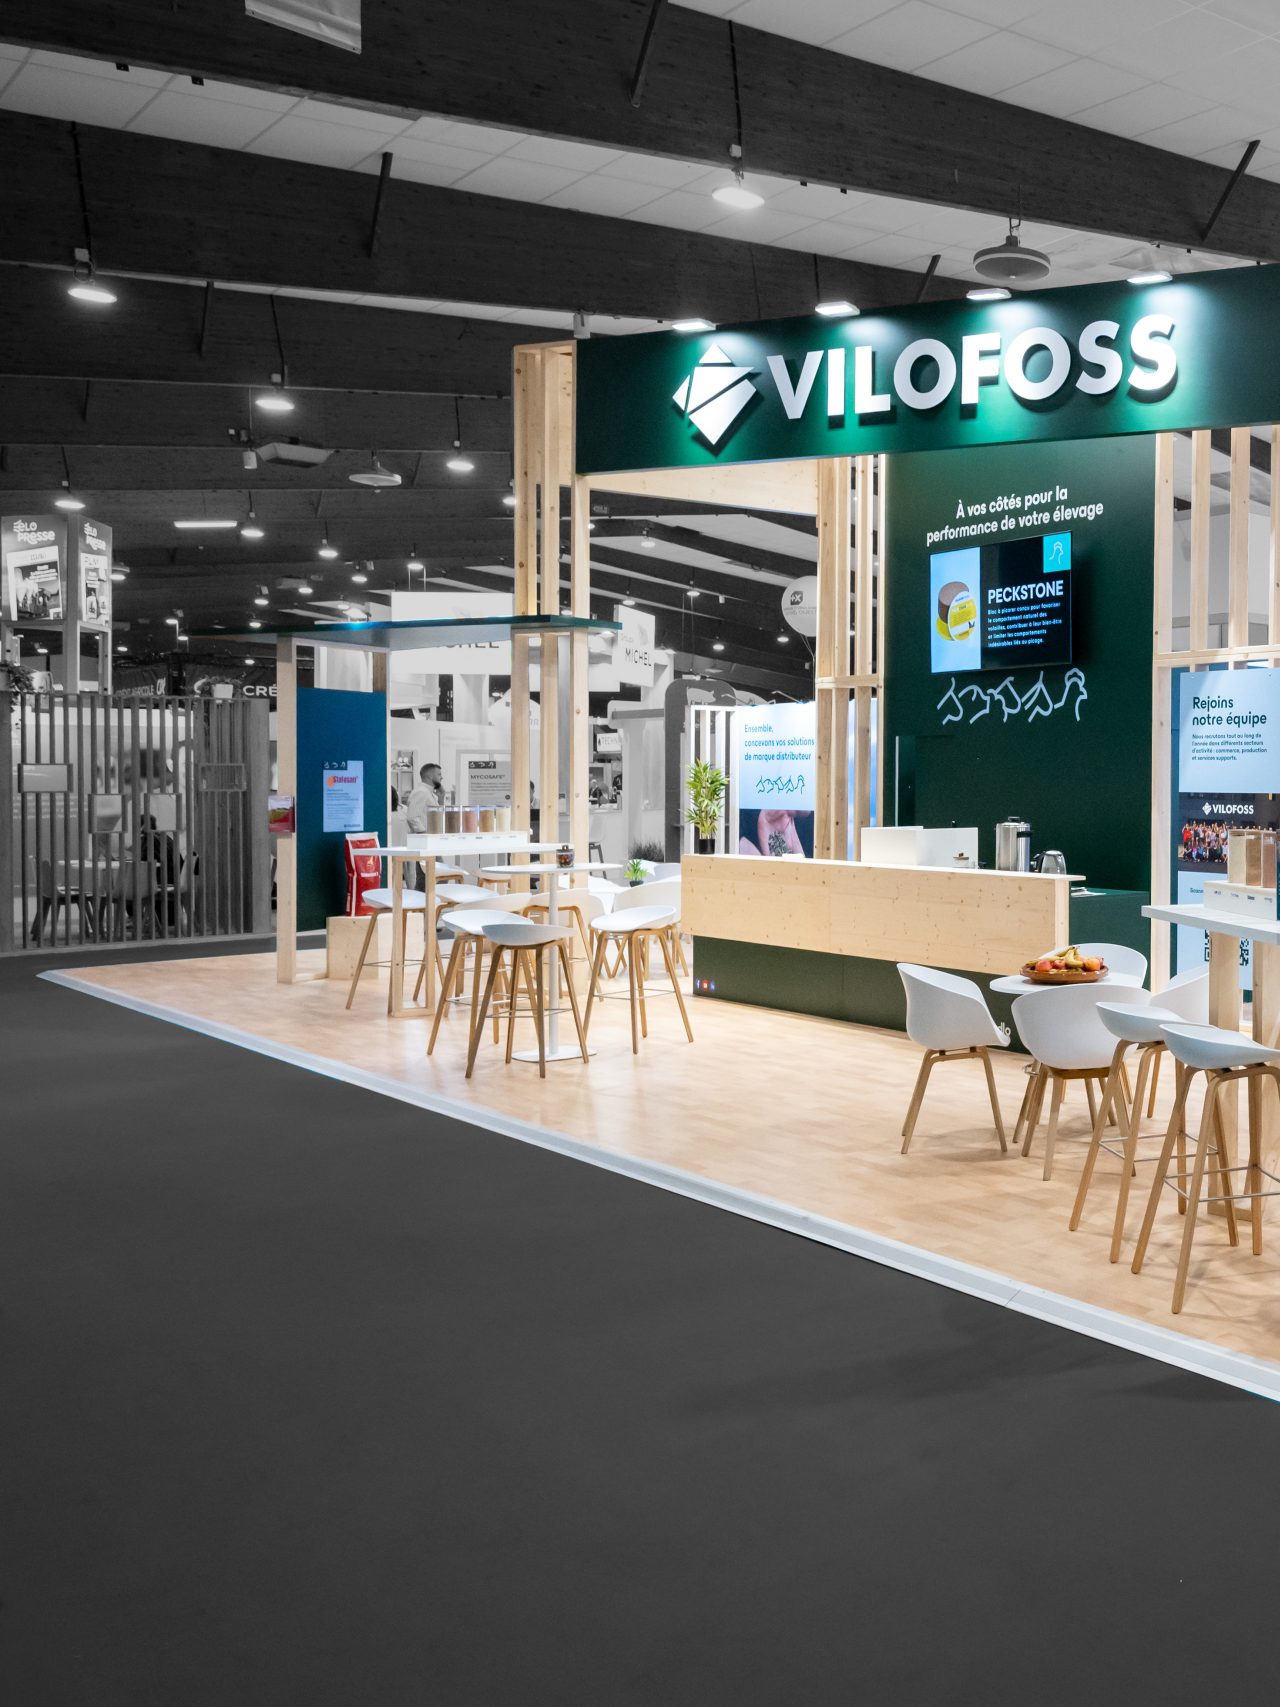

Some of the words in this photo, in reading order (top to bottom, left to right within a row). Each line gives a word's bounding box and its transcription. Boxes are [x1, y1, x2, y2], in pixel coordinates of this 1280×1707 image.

[767, 314, 1177, 420] VILOFOSS
[956, 500, 965, 519] À
[967, 503, 987, 517] vos
[989, 494, 1022, 513] côtés
[1024, 490, 1052, 510] pour
[1056, 485, 1068, 501] la
[926, 520, 998, 547] performance
[1000, 515, 1016, 531] de
[1018, 511, 1050, 528] votre
[1053, 503, 1104, 522] élevage
[988, 580, 1064, 604] PECKSTONE
[993, 615, 1022, 623] comportement
[1014, 629, 1047, 637] comportements
[625, 648, 651, 666] MICHEL
[243, 684, 277, 696] CRÉ
[1193, 696, 1234, 712] Rejoins
[1192, 713, 1223, 725] notre
[1226, 711, 1267, 728] équipe
[744, 723, 774, 734] Ensemble,
[776, 739, 786, 747] vos
[787, 737, 815, 746] solutions
[744, 752, 752, 761] de
[752, 754, 775, 763] marque
[776, 752, 811, 761] distributeur
[1212, 804, 1254, 814] VILOFOSS
